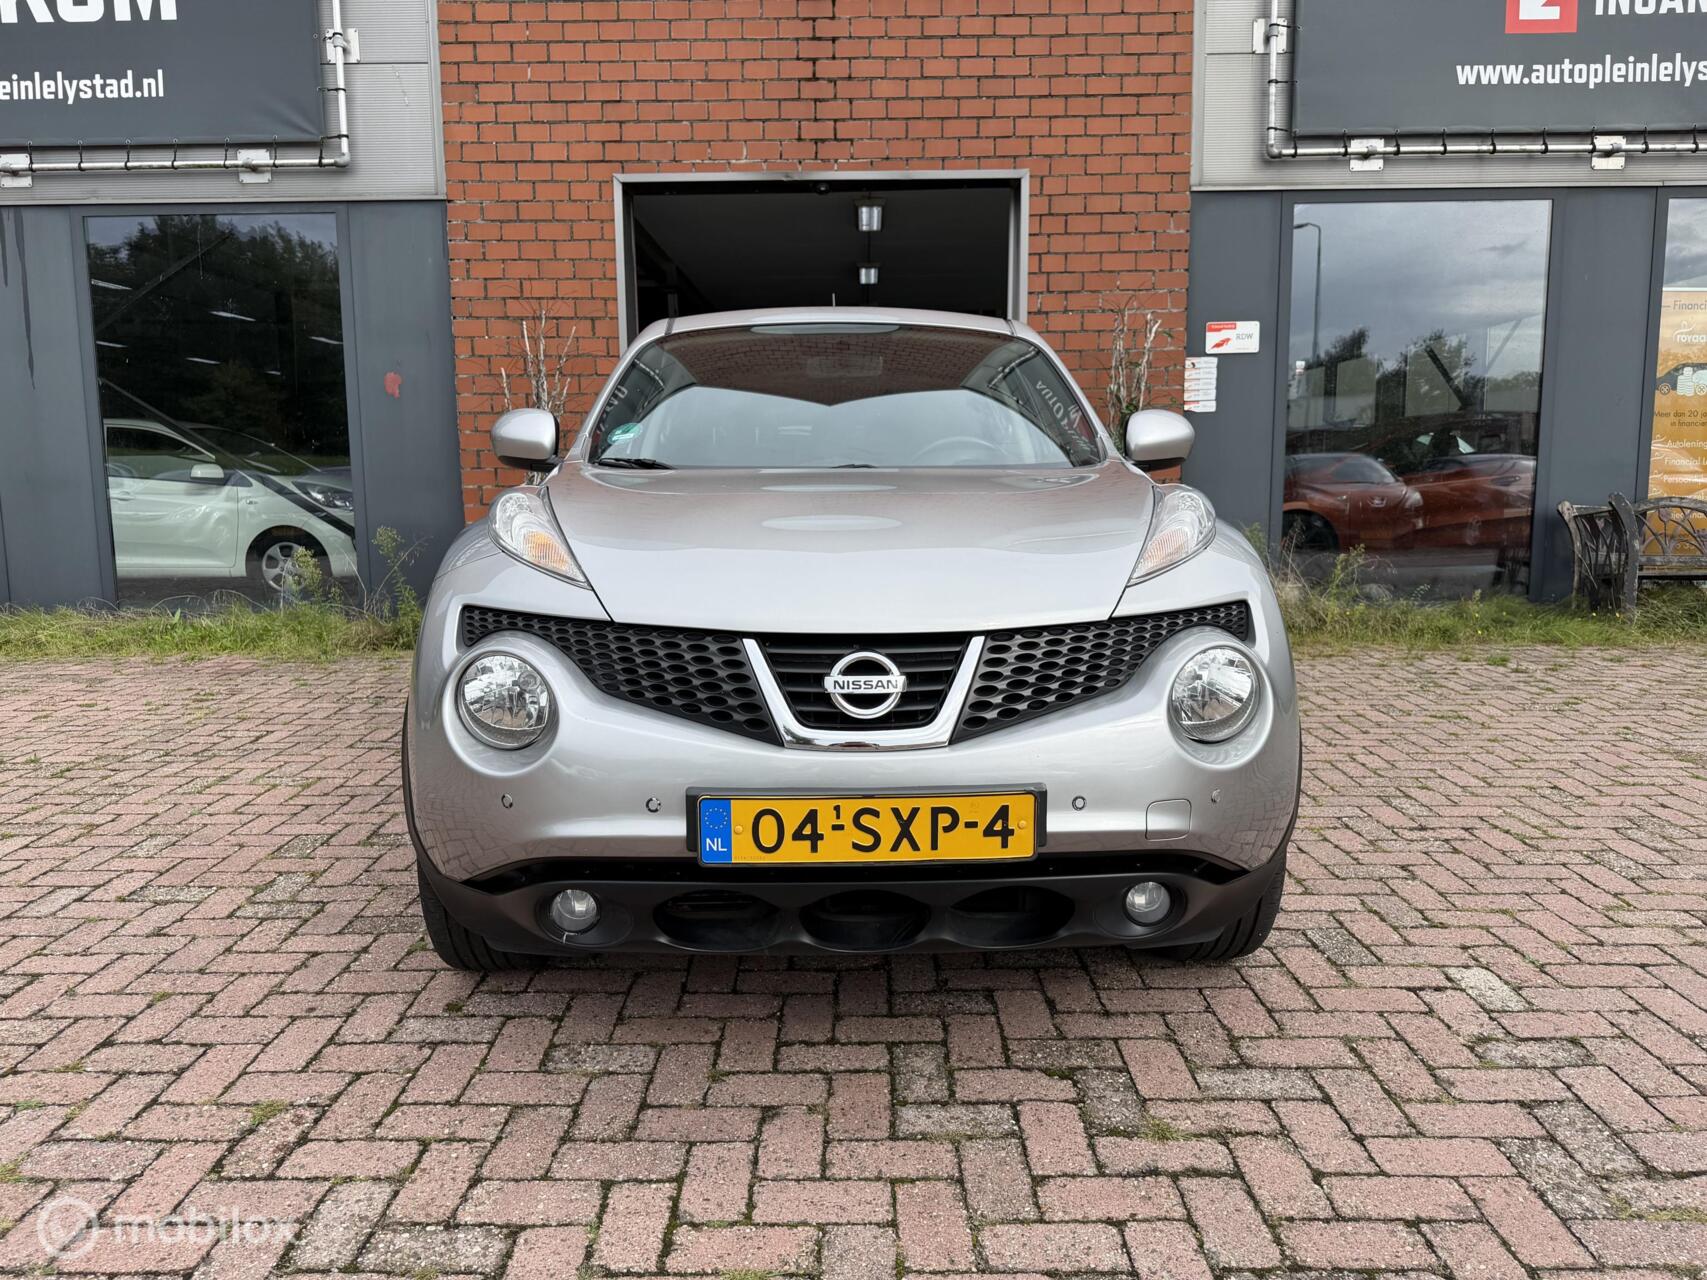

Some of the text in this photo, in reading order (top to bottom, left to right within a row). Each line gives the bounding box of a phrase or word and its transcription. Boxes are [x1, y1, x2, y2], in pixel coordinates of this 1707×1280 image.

[1456, 53, 1707, 89] www.autopleinlelys
[0, 69, 164, 104] einlelystad.nl
[833, 679, 898, 690] NISSAN
[706, 838, 727, 851] NL
